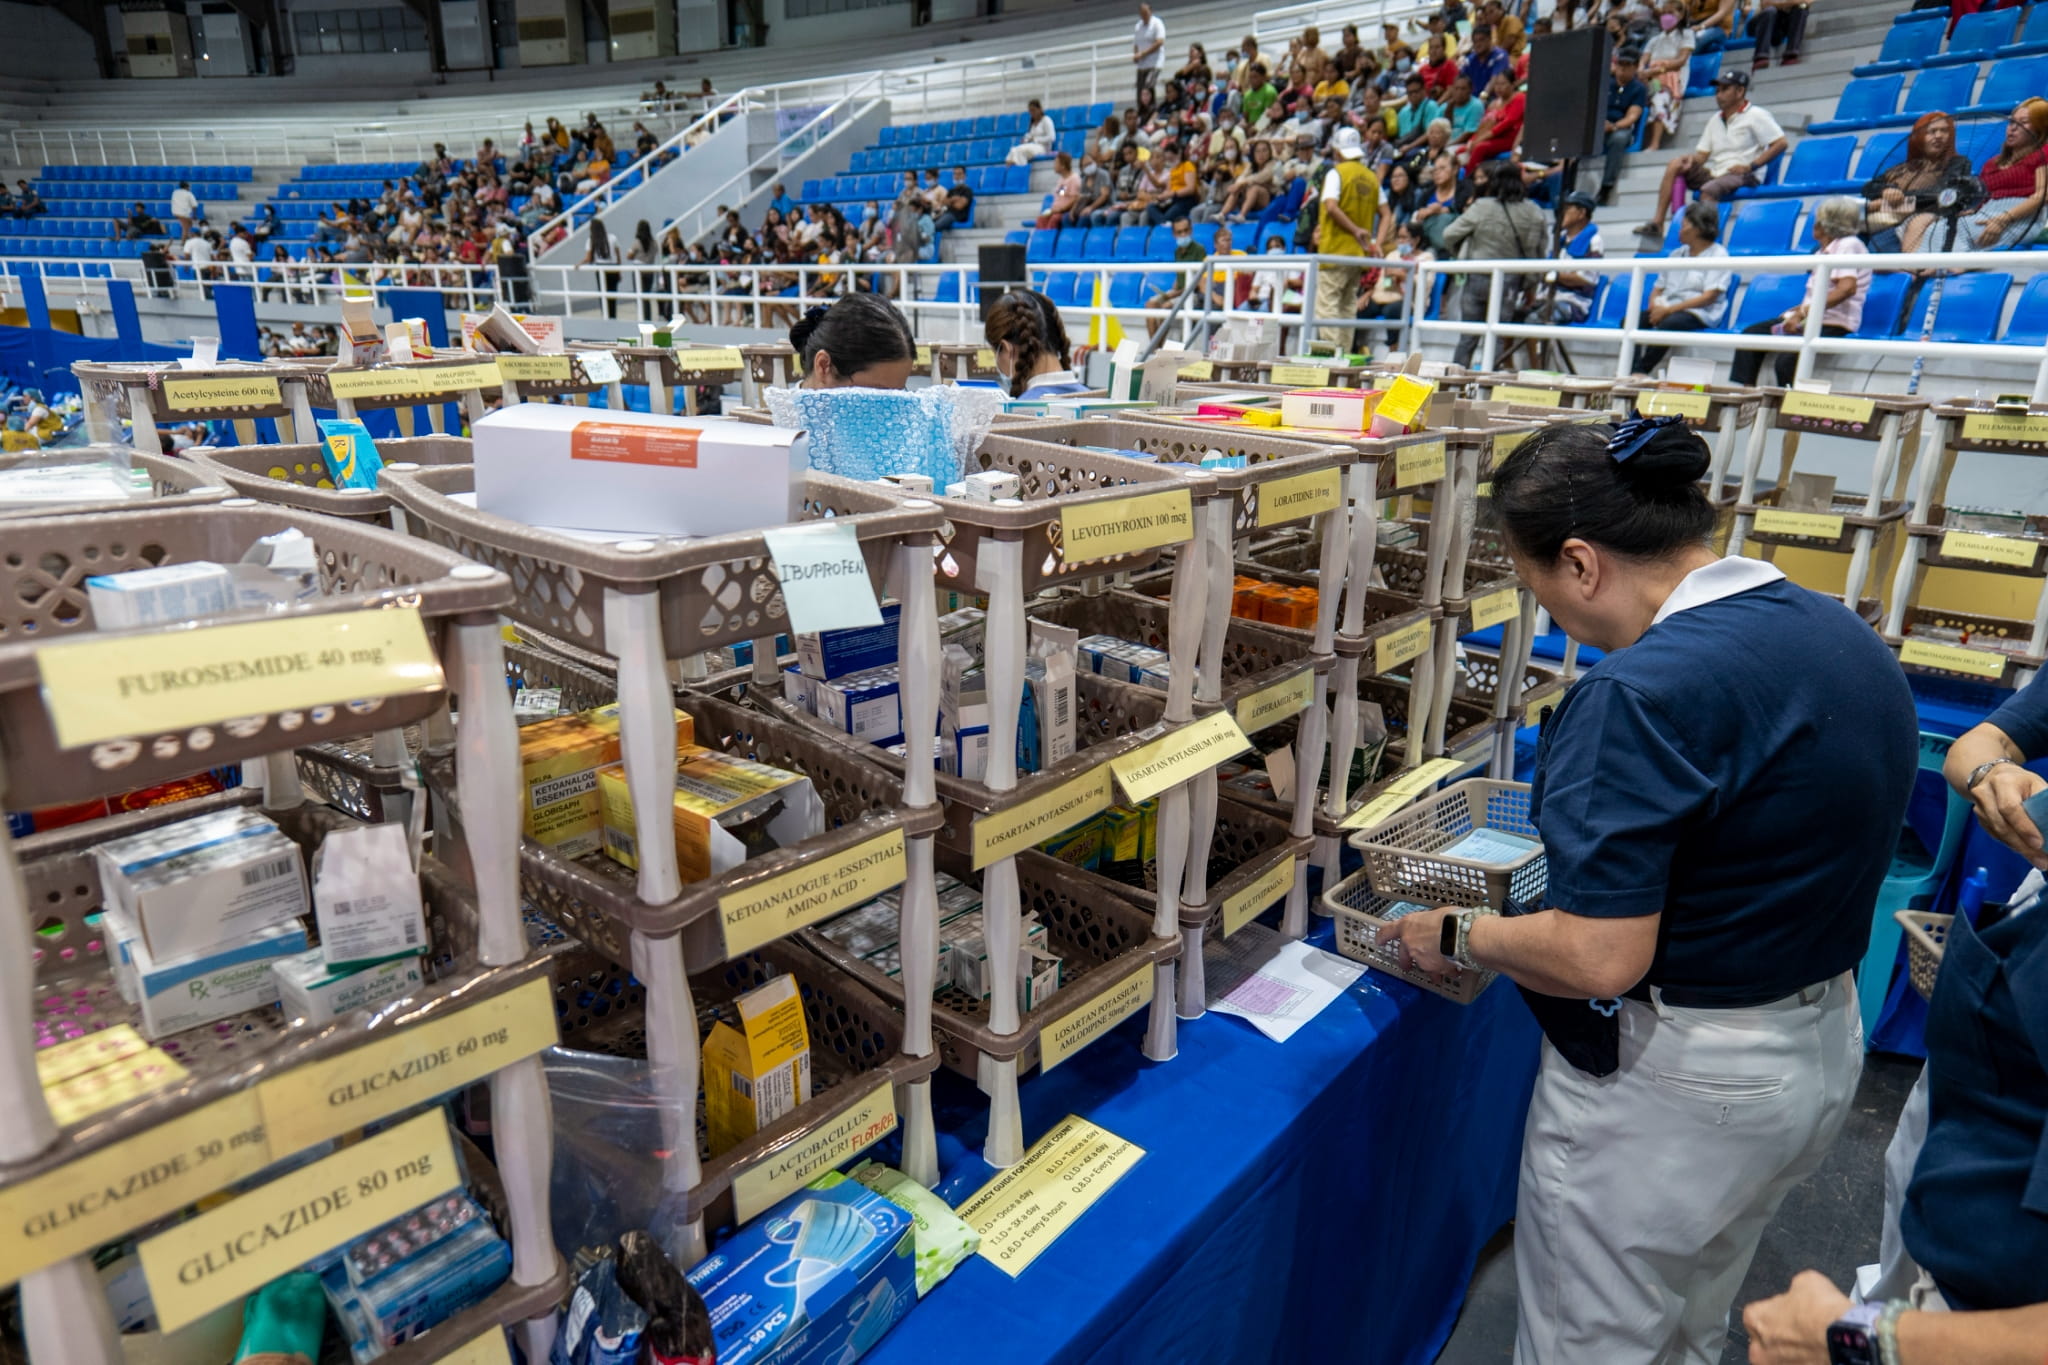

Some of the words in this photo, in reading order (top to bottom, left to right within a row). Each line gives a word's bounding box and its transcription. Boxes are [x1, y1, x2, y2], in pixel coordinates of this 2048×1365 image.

[172, 387, 240, 401] Acetylcysteine
[241, 386, 258, 396] 600
[260, 387, 275, 398] mg
[336, 380, 374, 390] AMLODIPINE
[376, 378, 404, 387] BESILATE
[1978, 423, 2038, 433] TELEMISARTAN
[1274, 488, 1314, 508] LORATIDINE
[1314, 488, 1322, 500] 10
[1322, 487, 1330, 498] mg
[1072, 516, 1154, 542] LEVOTHYROXIN
[1155, 512, 1170, 526] 100
[1170, 511, 1188, 526] mcg
[780, 560, 864, 583] IBUPROFEN
[118, 652, 312, 698] FUROSEMIDE
[318, 647, 346, 667] 40
[350, 645, 385, 667] mg
[1252, 694, 1293, 718] LOPERAMIDE
[1126, 759, 1170, 784] LOSARTAN
[1168, 738, 1212, 766] POTASSIUM
[1212, 732, 1224, 745] 100
[1224, 729, 1236, 740] mg
[535, 771, 595, 797] KETOANALOG
[536, 784, 584, 806] ESSENTIAL
[985, 820, 1036, 849] LOSARTAN
[1036, 794, 1084, 826] POTASSIUM
[1083, 792, 1094, 803] 50
[1092, 785, 1105, 800] mg
[726, 873, 831, 925] KETOANALOGUE
[833, 842, 904, 882] +ESSENTIALS
[786, 892, 828, 918] AMINO
[830, 878, 858, 900] ACID
[1238, 875, 1284, 915] MULTIVITAMINS
[1054, 1006, 1098, 1042] LOSARTAN
[1097, 983, 1139, 1016] POTASSIUM
[1059, 1016, 1108, 1052] AMLODIPINE
[326, 1046, 454, 1108] GLICAZIDE
[456, 1038, 479, 1060] 60
[480, 1024, 510, 1051] mg
[768, 1110, 869, 1181] LACTOBACILLUS
[794, 1140, 850, 1181] RETILERI
[994, 1174, 1016, 1192] GUIDE
[1014, 1164, 1028, 1178] FOR
[1025, 1142, 1054, 1167] MEDICINE
[1052, 1124, 1074, 1144] COUNT
[1046, 1158, 1064, 1174] B.I.D
[1064, 1141, 1083, 1158] Twice
[1086, 1129, 1100, 1142] day
[1082, 1153, 1094, 1164] 4X
[1096, 1142, 1110, 1155] day
[1094, 1158, 1112, 1174] Every
[1113, 1142, 1130, 1158] hours
[22, 1152, 188, 1240] GLICAZIDE
[194, 1137, 225, 1165] 30
[228, 1120, 267, 1152] mg
[176, 1184, 354, 1287] GLICAZIDE
[358, 1168, 390, 1201] 80
[394, 1152, 434, 1186] mg
[978, 1220, 994, 1236] O.D
[996, 1202, 1016, 1220] Once
[1020, 1188, 1034, 1202] day
[990, 1230, 1008, 1246] T.I.D
[1011, 1218, 1023, 1230] 3X
[1026, 1202, 1041, 1218] day
[1024, 1220, 1046, 1239] Every
[1048, 1200, 1068, 1218] hours
[750, 1328, 766, 1344] 50
[764, 1311, 788, 1332] PCS
